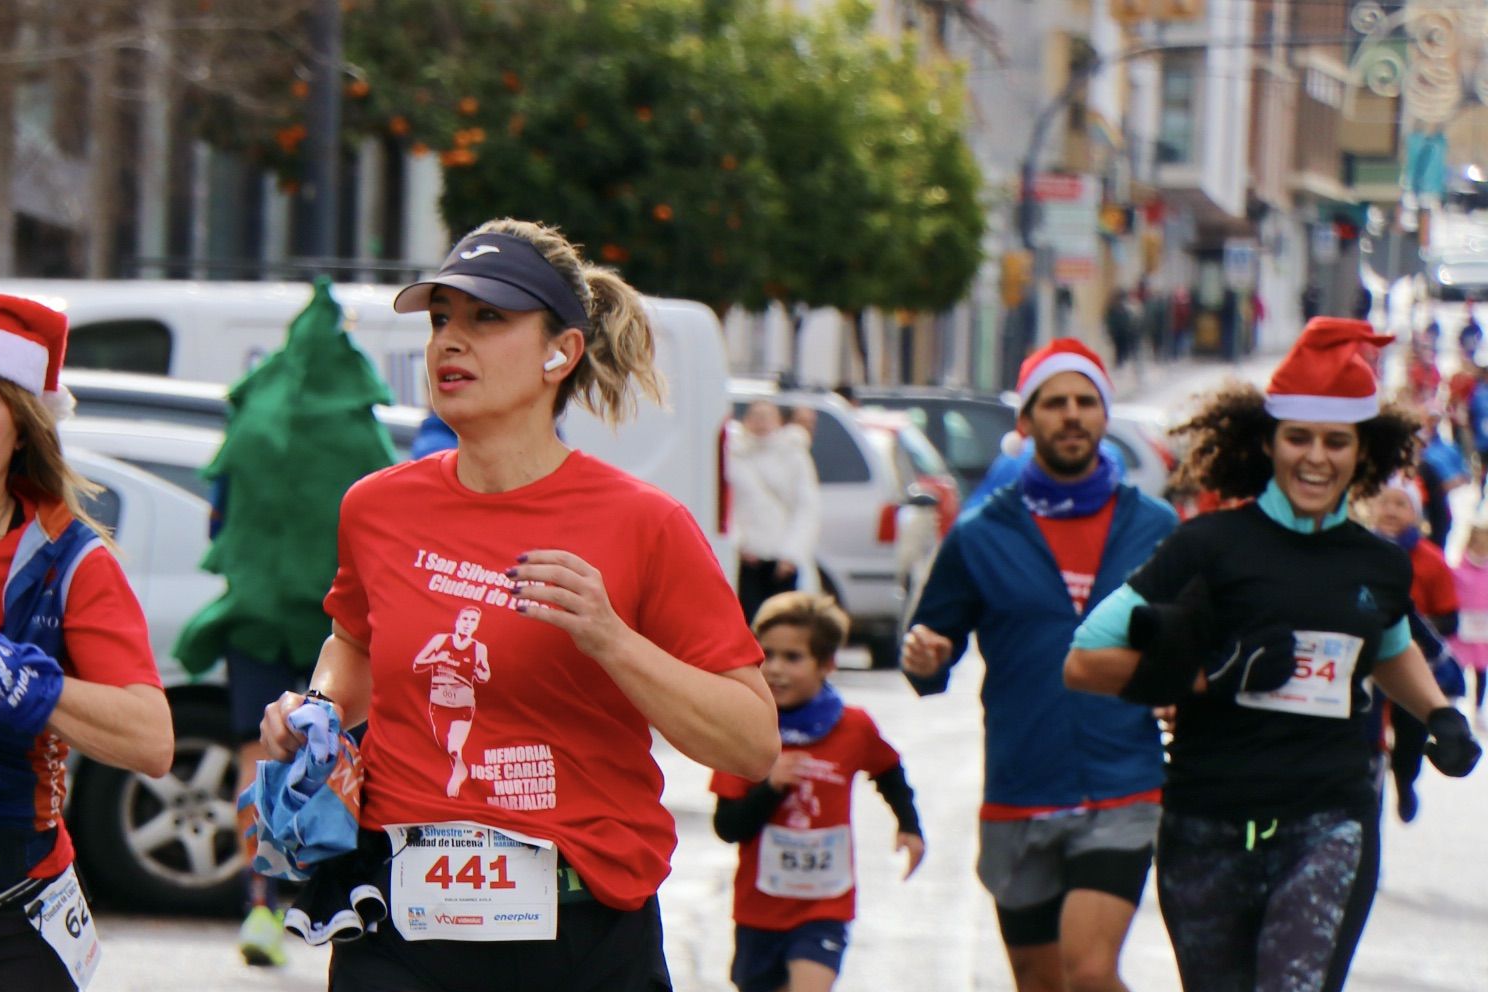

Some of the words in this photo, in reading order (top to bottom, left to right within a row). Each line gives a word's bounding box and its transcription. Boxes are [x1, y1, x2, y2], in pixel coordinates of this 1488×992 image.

[425, 552, 458, 575] San
[457, 561, 530, 589] Silves
[428, 573, 488, 602] Ciudad
[485, 588, 509, 607] de
[484, 744, 554, 765] MEMORIAL
[503, 759, 556, 780] CARLOS
[493, 776, 557, 796] HURTADO
[425, 855, 516, 889] 441
[494, 912, 540, 921] enerplus
